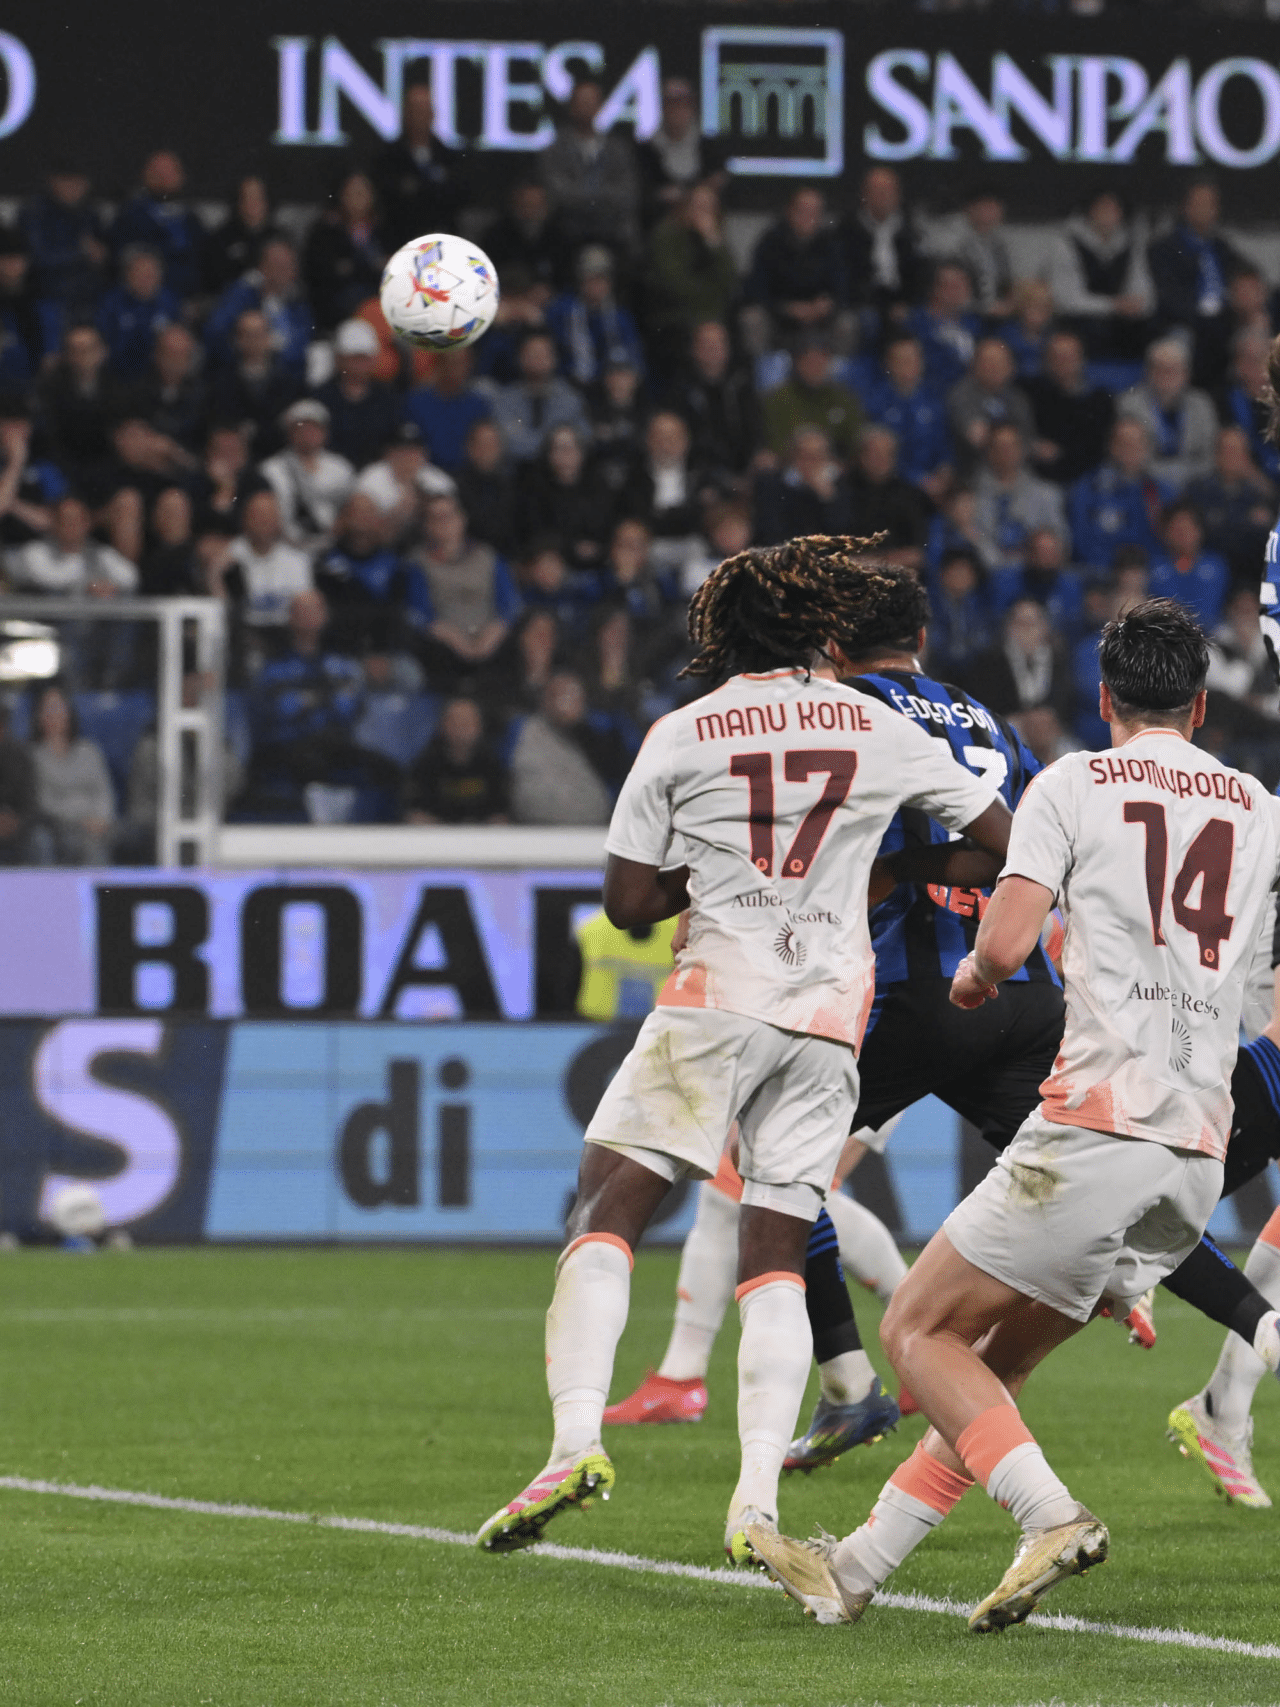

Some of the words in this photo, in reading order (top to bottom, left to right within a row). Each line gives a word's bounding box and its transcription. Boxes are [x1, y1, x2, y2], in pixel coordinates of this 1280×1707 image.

[272, 34, 664, 150] INTESA
[696, 703, 786, 742] MANU
[797, 702, 873, 731] KONE
[730, 749, 858, 880] 17
[1123, 801, 1235, 971] 14
[336, 1057, 472, 1210] di
